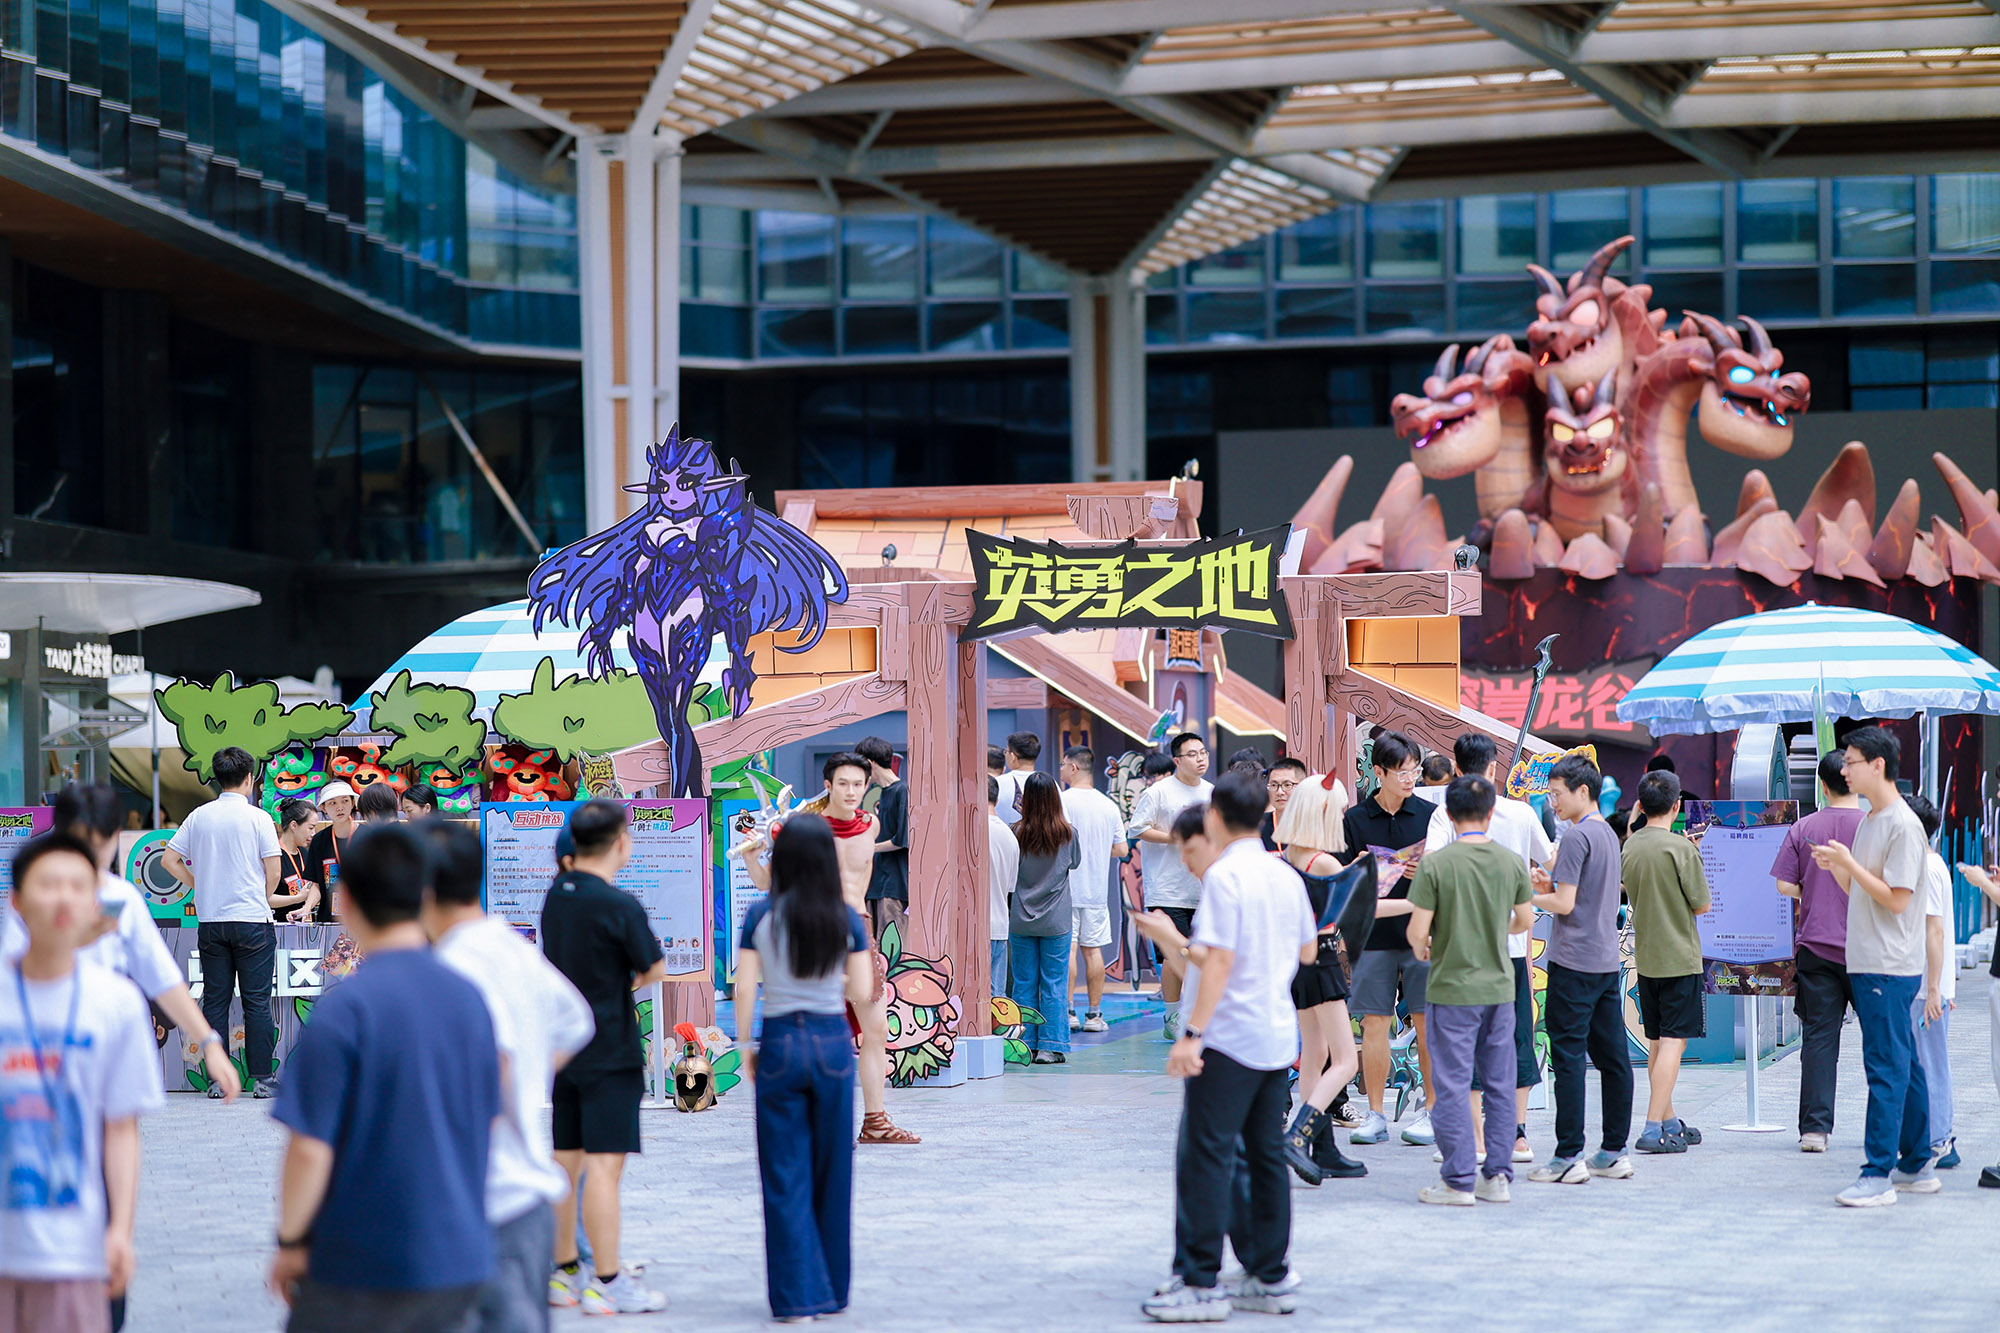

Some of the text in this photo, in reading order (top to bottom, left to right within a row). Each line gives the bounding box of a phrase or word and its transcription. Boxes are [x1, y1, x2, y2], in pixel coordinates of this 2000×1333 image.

[977, 540, 1279, 628] 英勇之地
[514, 812, 561, 826] 互动挑战
